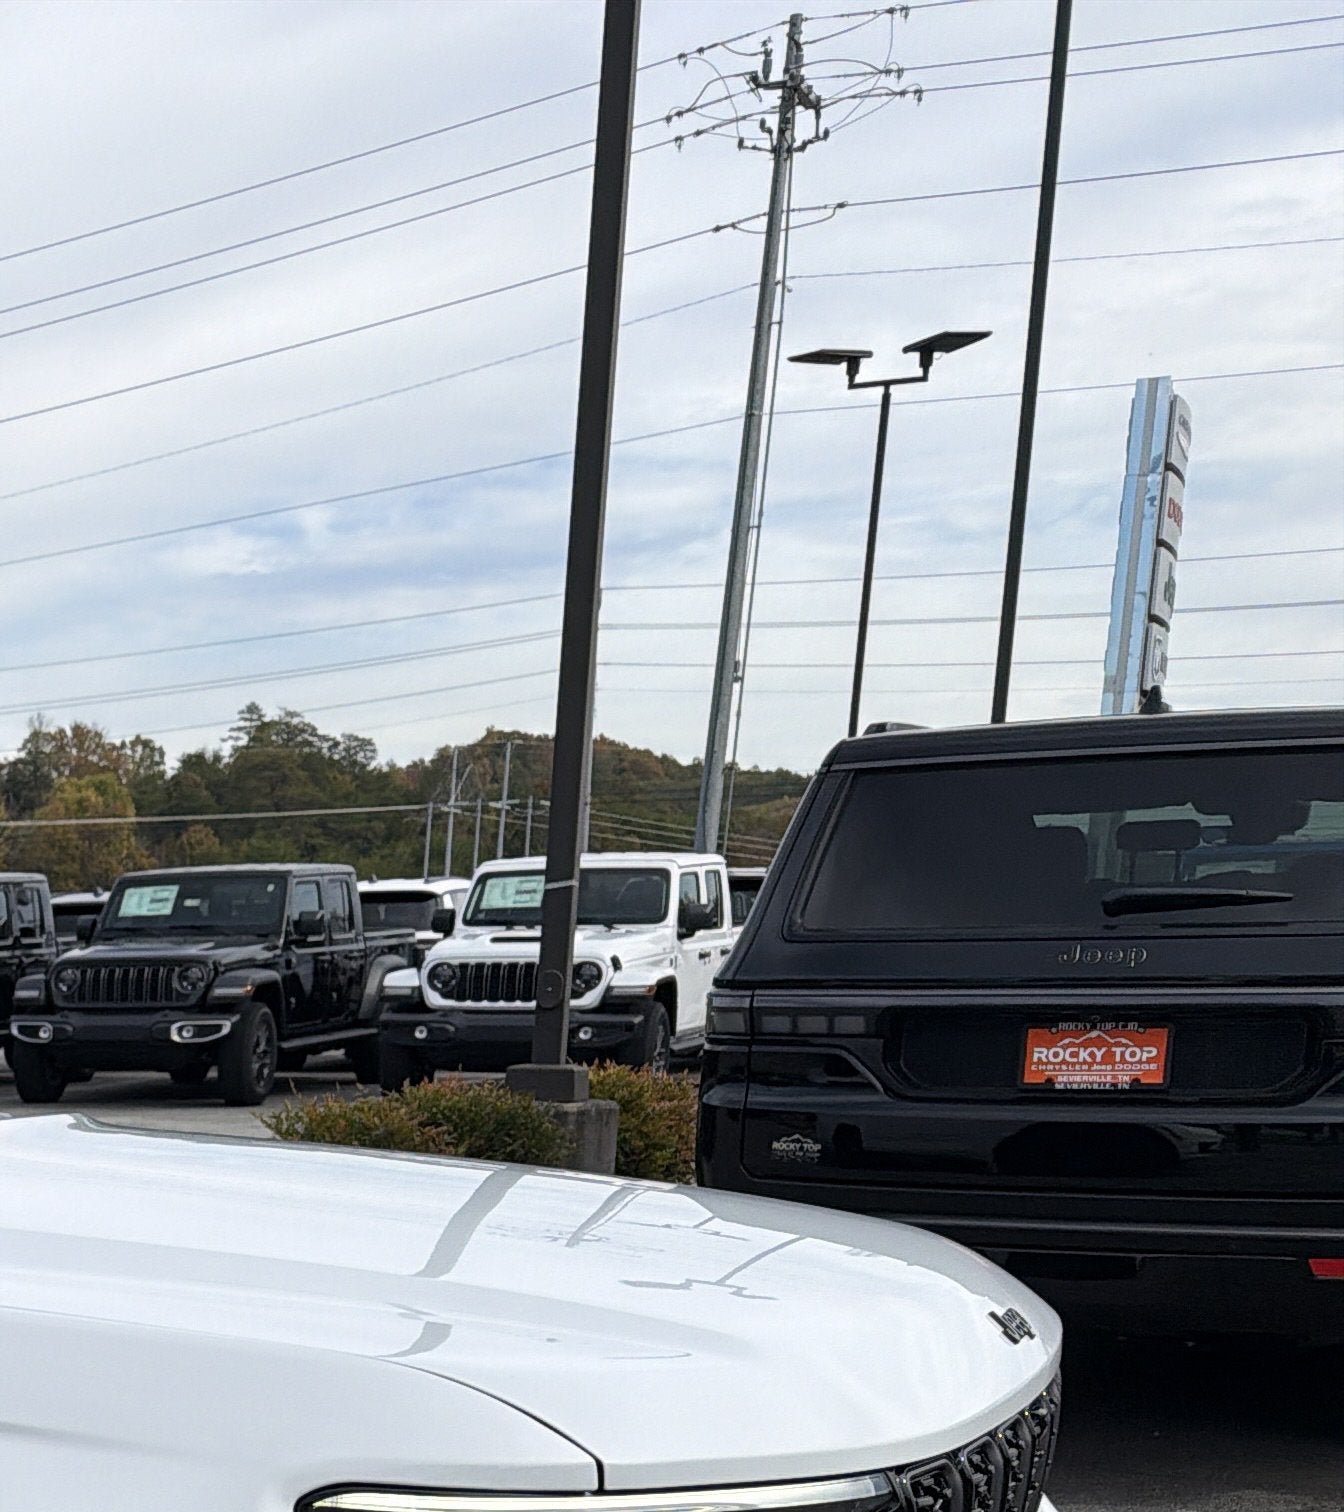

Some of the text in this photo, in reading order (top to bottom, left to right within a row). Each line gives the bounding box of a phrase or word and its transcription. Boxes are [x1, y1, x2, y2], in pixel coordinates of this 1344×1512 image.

[1057, 943, 1147, 968] Jeep
[1058, 1022, 1091, 1031] ROCKY
[1096, 1022, 1115, 1031] TOP
[1032, 1047, 1158, 1063] ROCKY TOP
[1031, 1063, 1088, 1071] CHRYSLER
[1091, 1063, 1112, 1071] Jeep
[772, 1141, 822, 1152] ROCKY TOP
